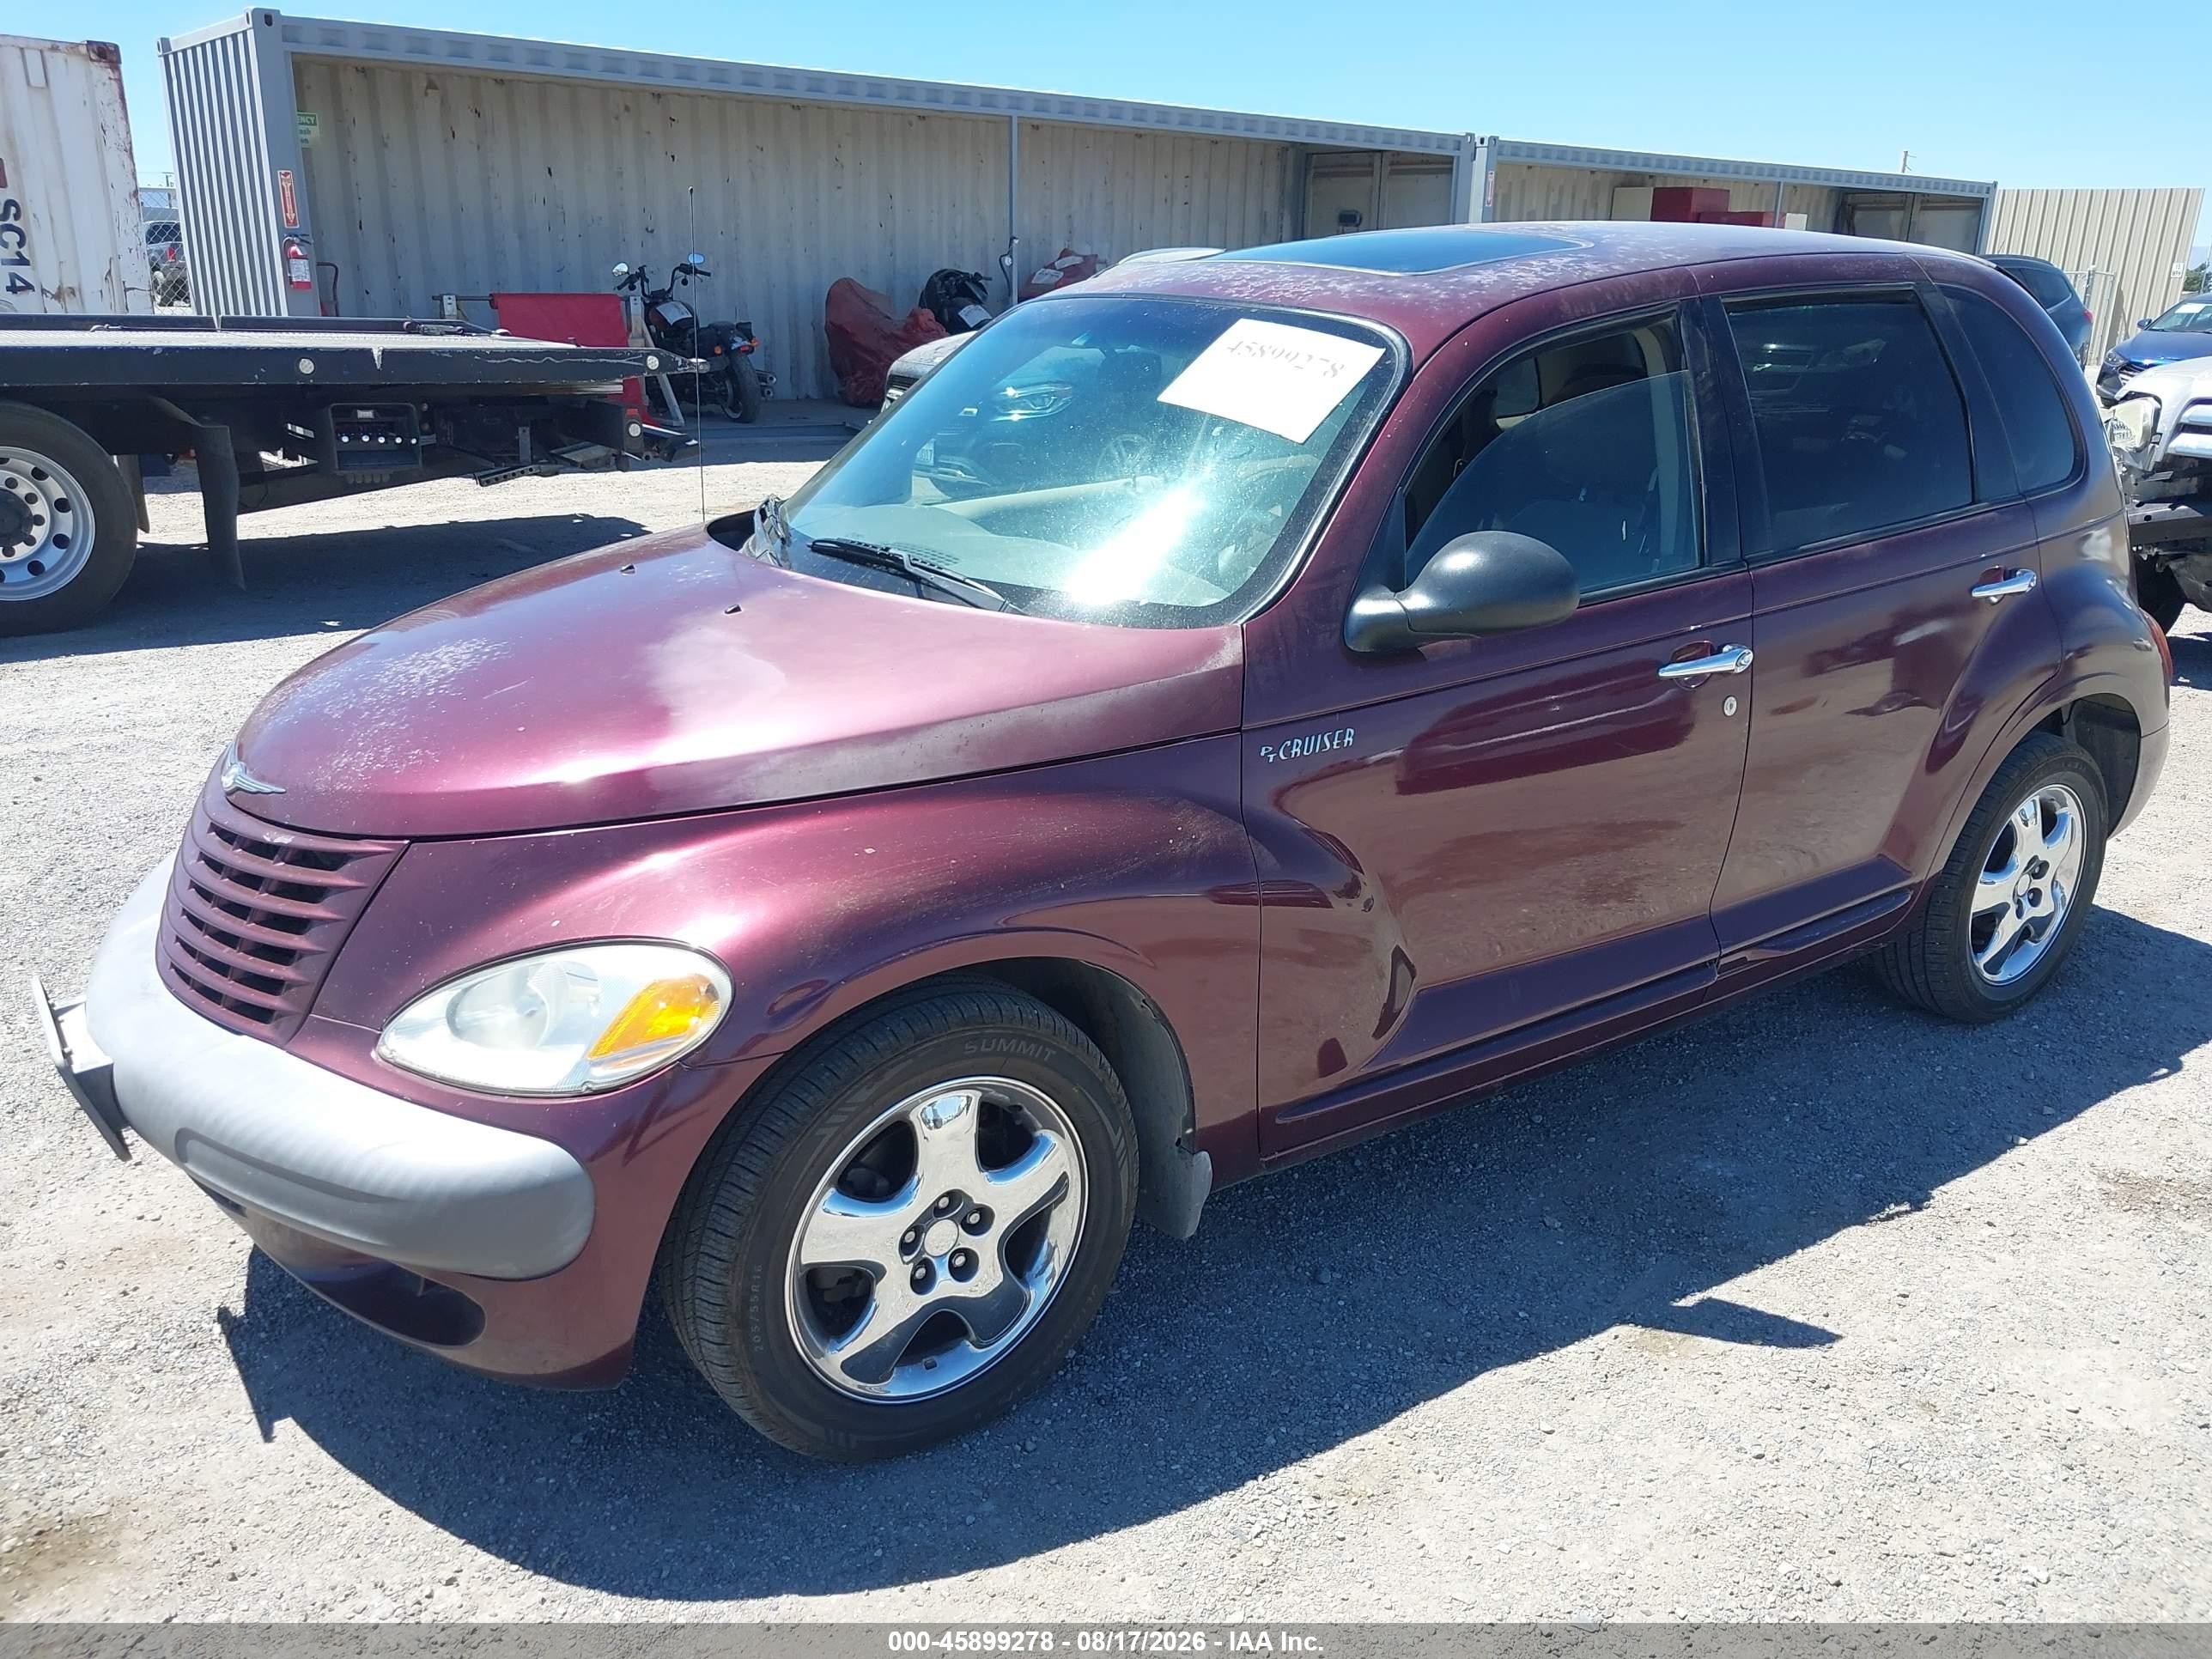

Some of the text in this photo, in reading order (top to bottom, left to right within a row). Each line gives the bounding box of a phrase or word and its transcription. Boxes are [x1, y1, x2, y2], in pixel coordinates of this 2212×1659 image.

[0, 198, 35, 295] SC14
[1279, 727, 1355, 760] CRUISER
[963, 1037, 1057, 1062] SUMMIT
